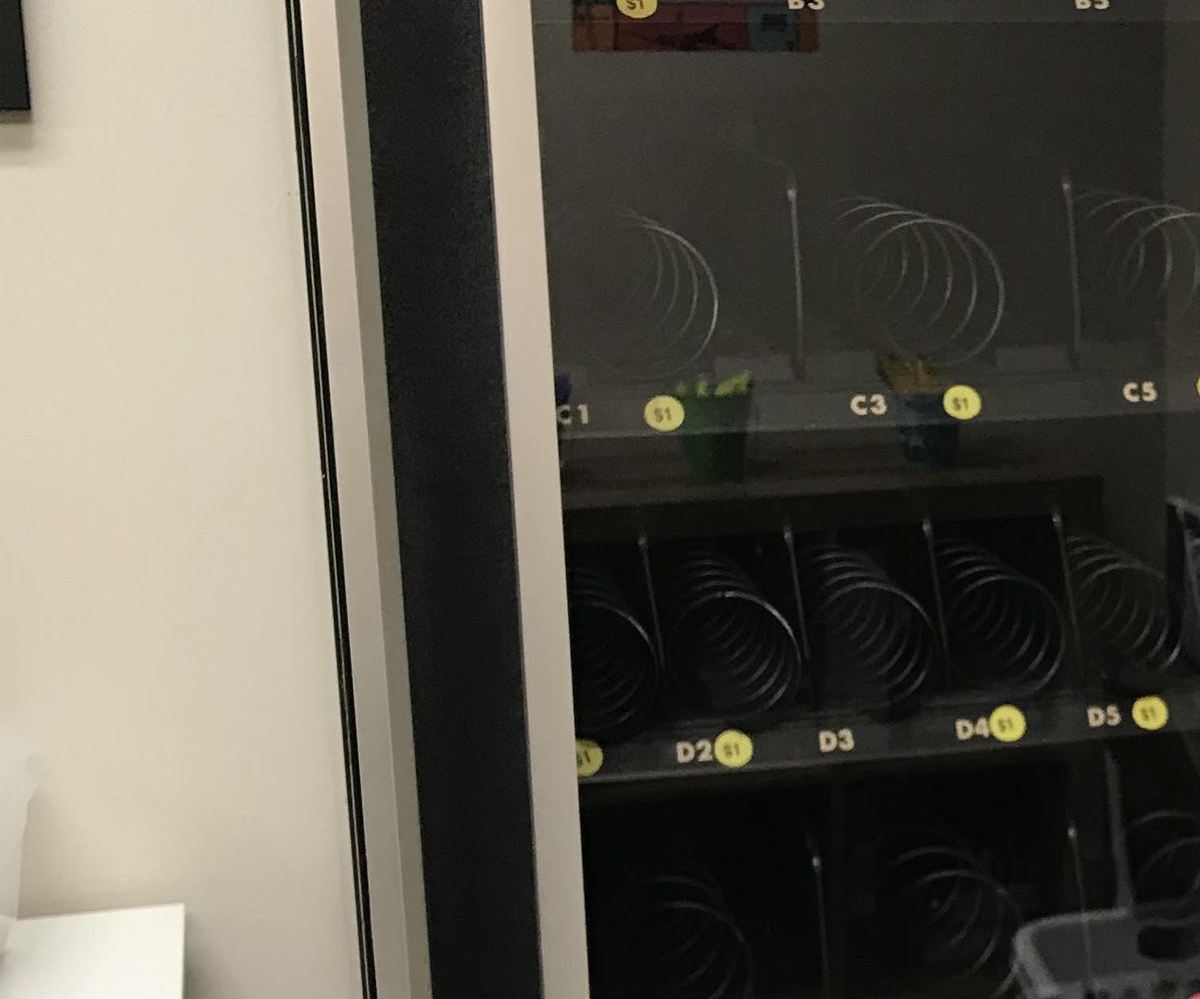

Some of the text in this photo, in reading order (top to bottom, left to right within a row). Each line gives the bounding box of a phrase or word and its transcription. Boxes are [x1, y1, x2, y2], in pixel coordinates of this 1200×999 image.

[1122, 380, 1158, 403] C5
[557, 403, 590, 426] C1
[850, 394, 888, 416] C3
[1086, 705, 1122, 727] D5
[819, 728, 855, 753] D3
[955, 717, 989, 741] D4
[676, 741, 713, 764] D2
